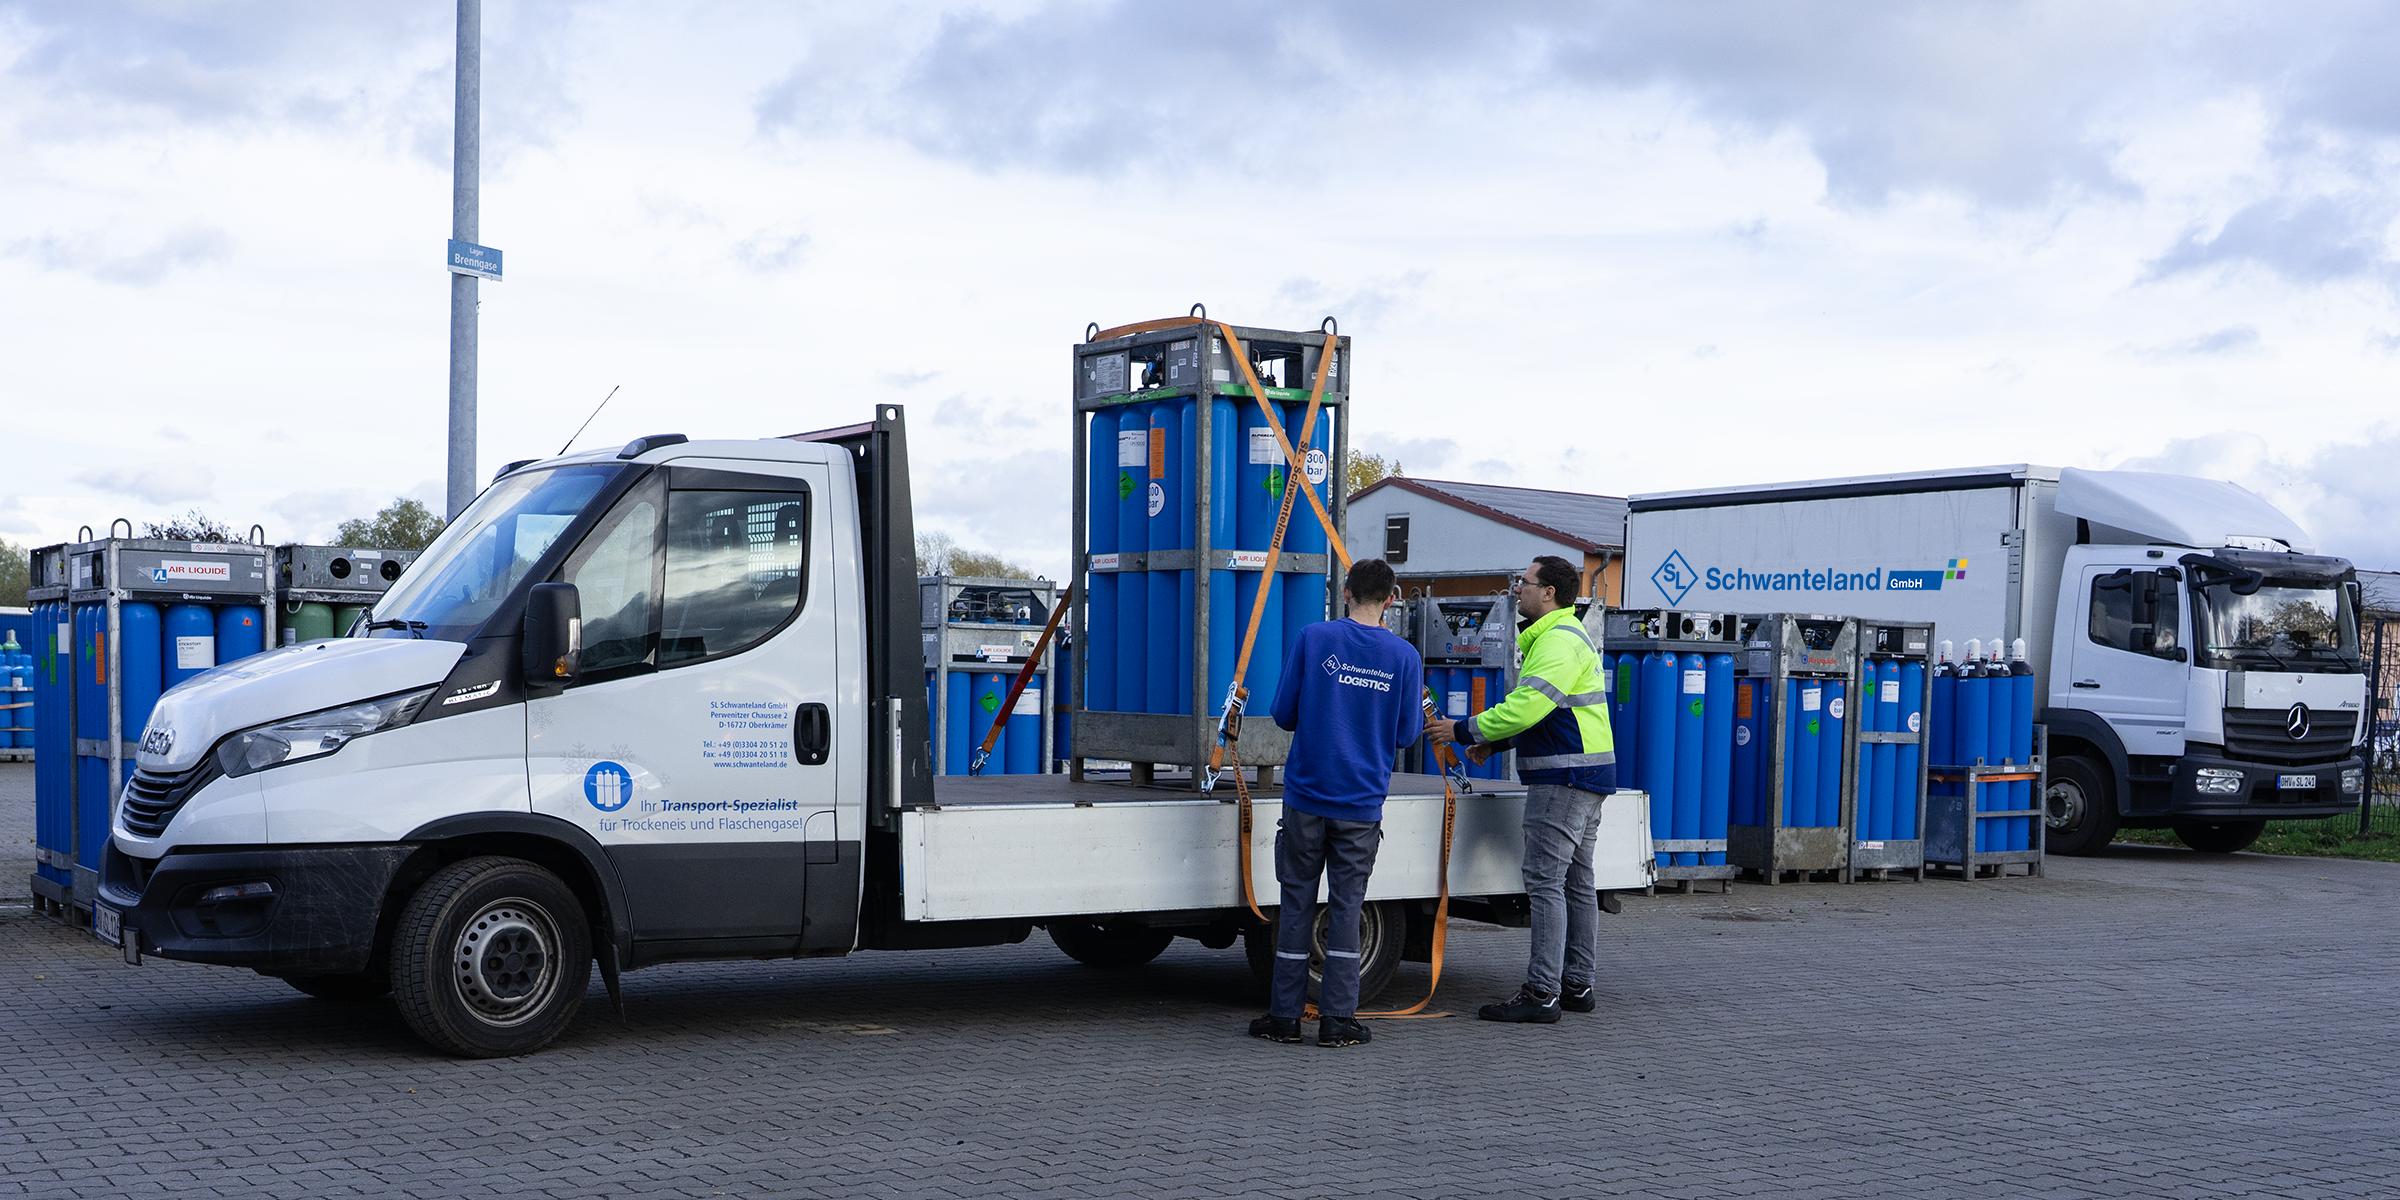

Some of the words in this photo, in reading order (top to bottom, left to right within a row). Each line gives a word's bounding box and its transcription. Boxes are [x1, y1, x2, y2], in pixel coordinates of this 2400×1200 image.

[470, 248, 484, 256] Lager
[455, 253, 497, 271] Brenngase
[1299, 440, 1308, 454] SL
[1306, 454, 1324, 464] 300
[1307, 465, 1323, 475] bar
[1273, 465, 1302, 549] Schwanteland
[1663, 563, 1686, 589] SL
[1706, 567, 1881, 591] Schwanteland
[1890, 578, 1922, 588] GmbH
[1327, 660, 1337, 669] SL
[1341, 663, 1394, 680] Schwanteland
[1338, 674, 1390, 692] LOGISTICS
[2296, 777, 2303, 786] SL
[2305, 777, 2315, 786] 241
[641, 800, 657, 812] Ihr
[661, 798, 798, 814] Transport-Spezialist
[599, 818, 617, 831] für
[621, 818, 686, 831] Trockeneis
[690, 818, 714, 830] und
[719, 818, 803, 832] Flaschengase!
